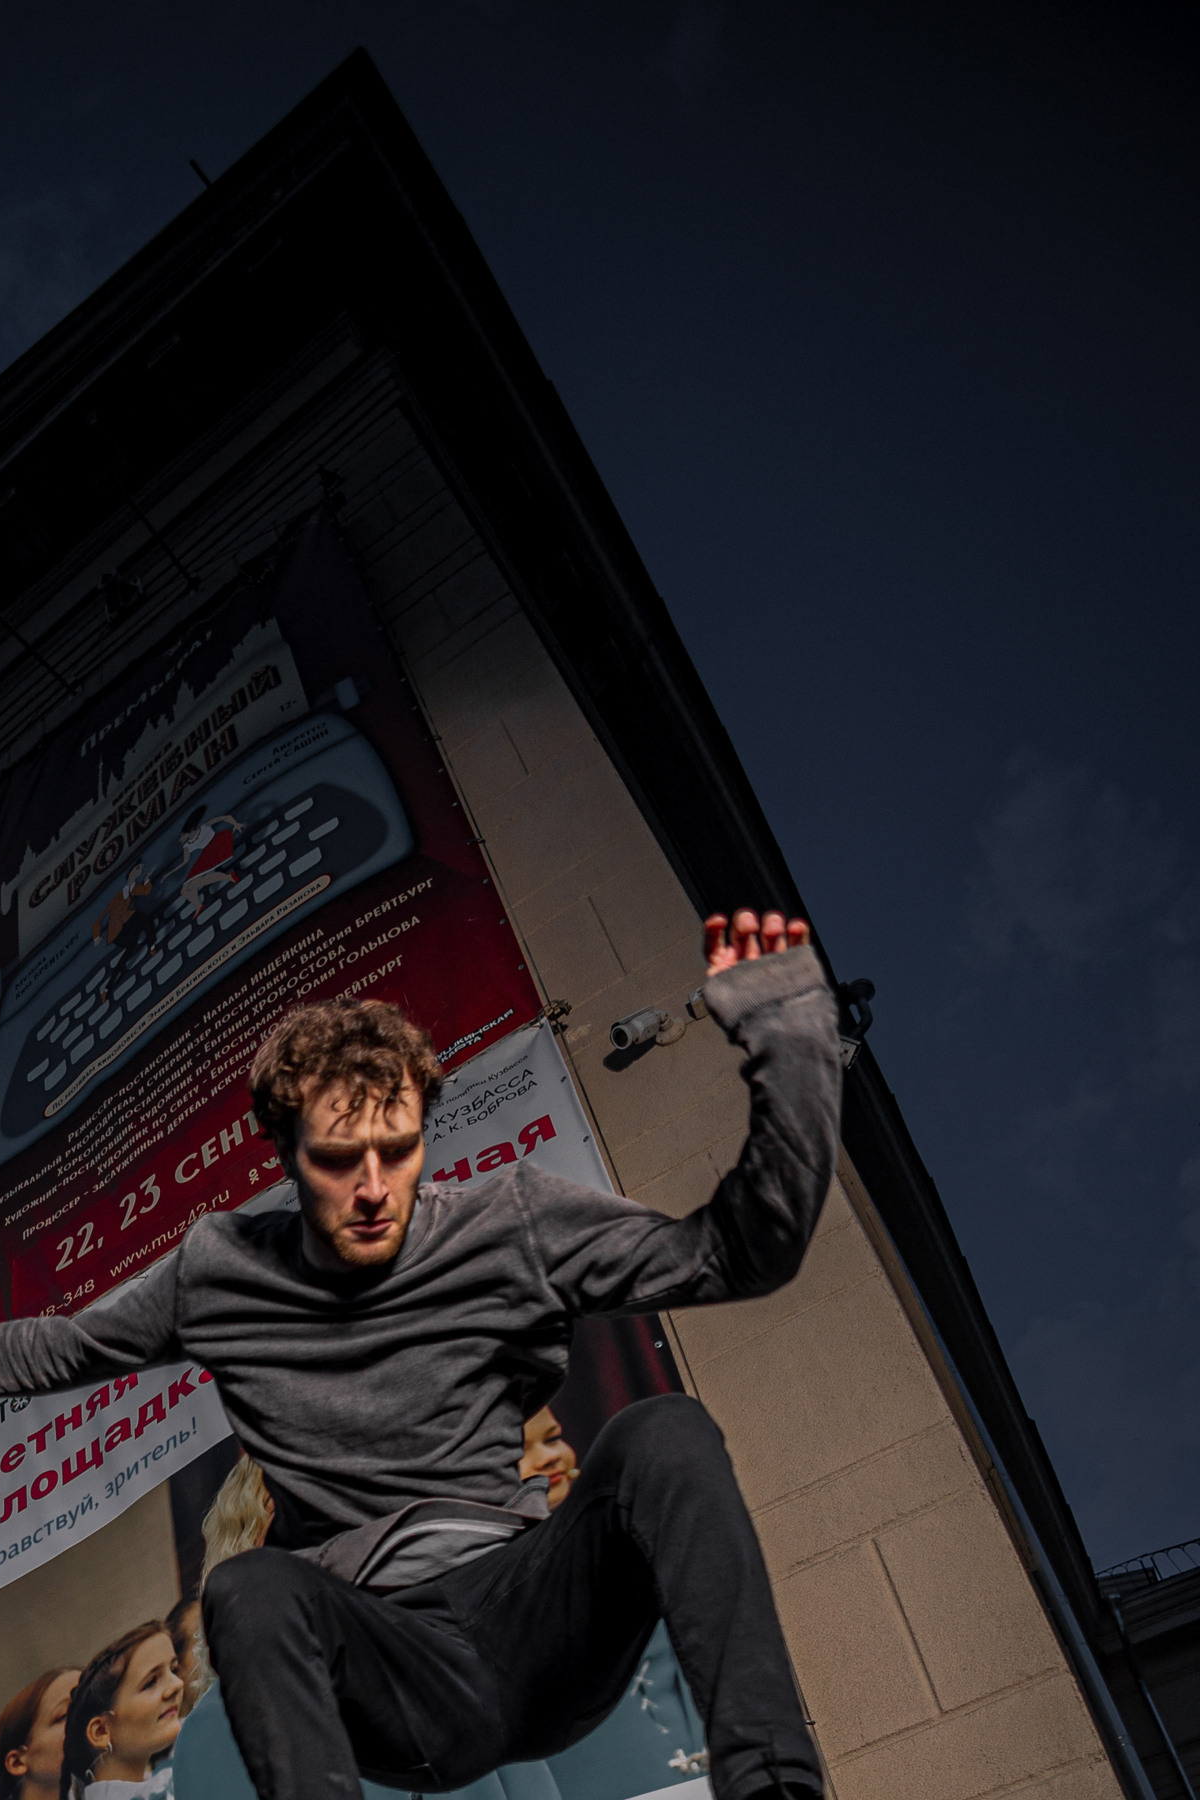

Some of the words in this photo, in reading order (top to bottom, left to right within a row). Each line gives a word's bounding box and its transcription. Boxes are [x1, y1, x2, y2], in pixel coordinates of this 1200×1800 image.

[29, 664, 282, 909] СЛУЖЕБНЫЙ
[67, 724, 239, 906] РОМАН
[355, 877, 433, 929] БРЕЙТБУРГ
[250, 928, 325, 987] ИНДЕЙКИНА
[338, 915, 420, 970] ГОЛЬЦОВА
[251, 944, 346, 1017] ХРОБОСТОВА
[328, 954, 403, 1006] РЕЙТБУРГ
[434, 1068, 534, 1128] КУЗБАССА
[487, 1054, 528, 1083] Кузбасса
[449, 1123, 463, 1133] К.
[466, 1080, 538, 1126] БОБРОВА
[55, 1221, 104, 1273] 22,
[119, 1173, 161, 1231] 23
[110, 1189, 230, 1278] www.muz42.ru
[104, 1416, 198, 1499] зритель!
